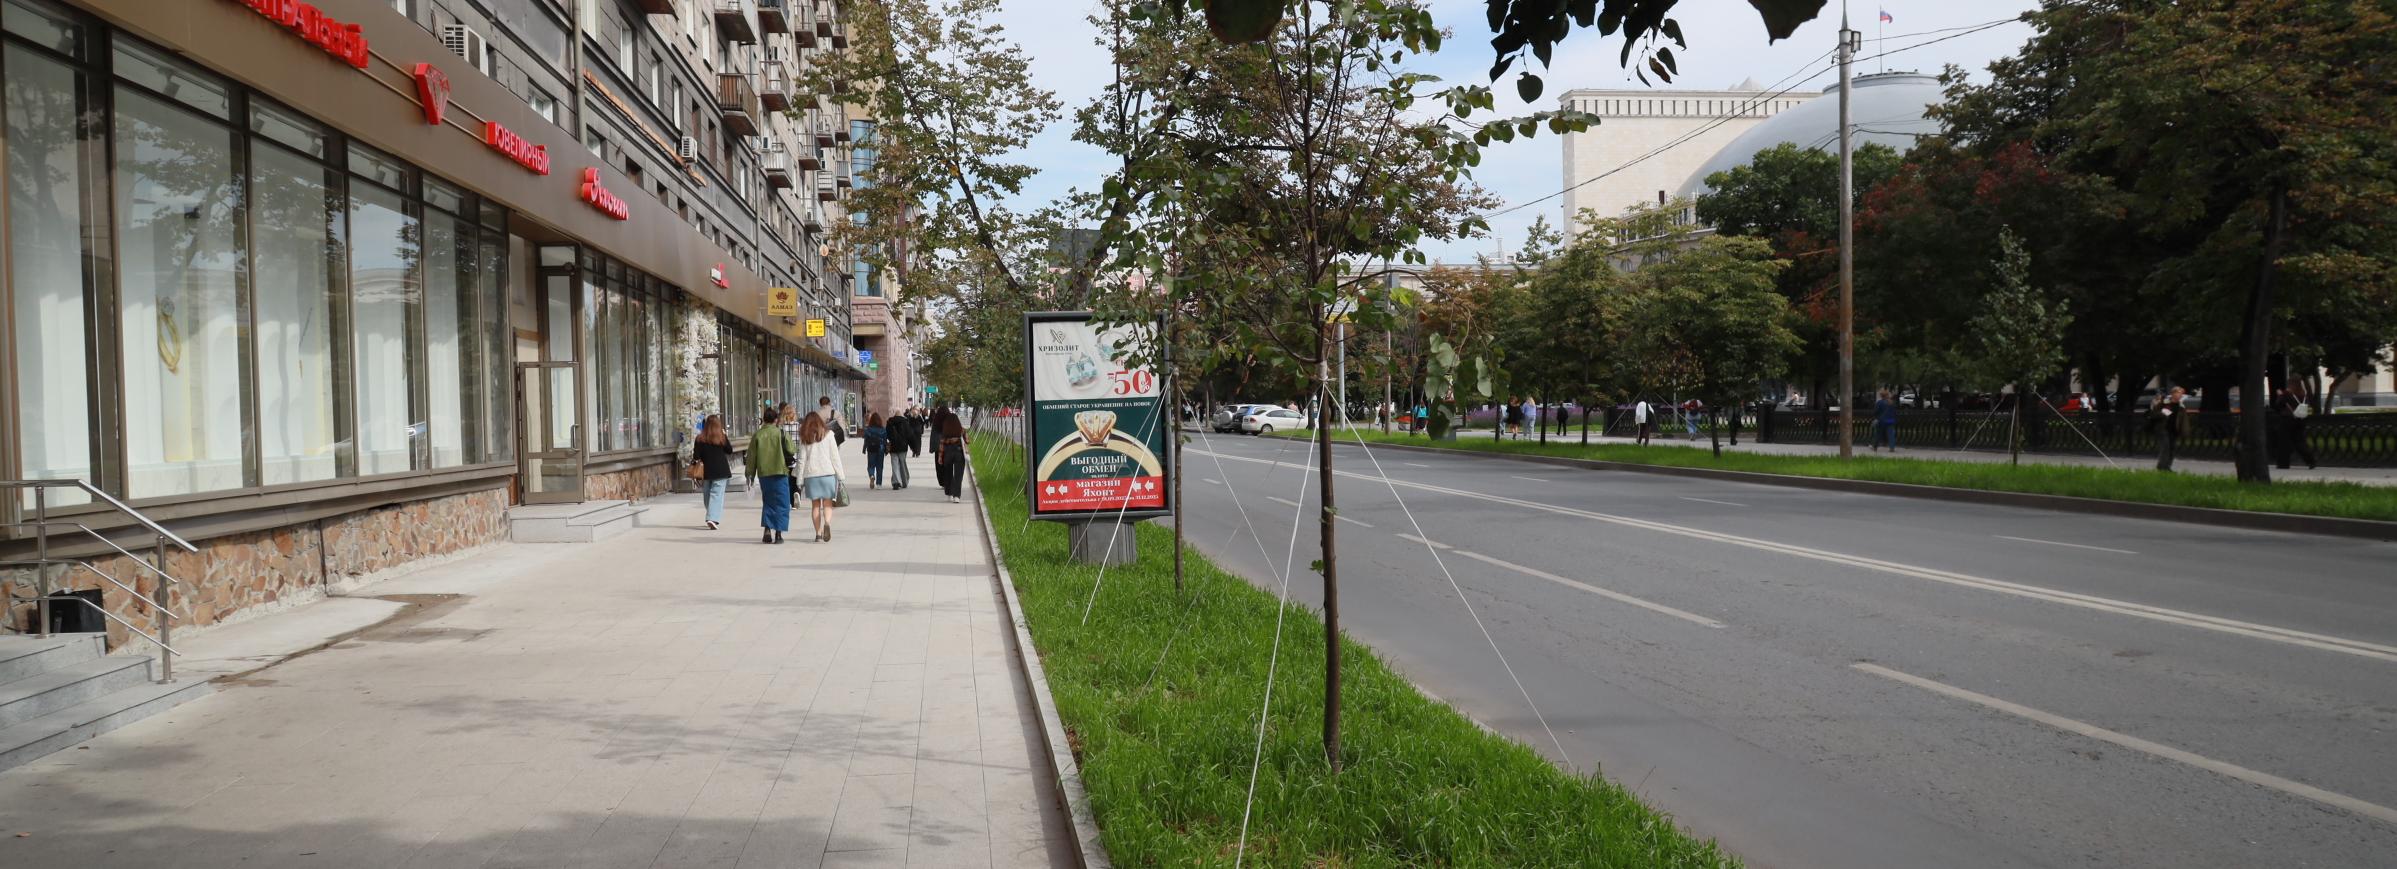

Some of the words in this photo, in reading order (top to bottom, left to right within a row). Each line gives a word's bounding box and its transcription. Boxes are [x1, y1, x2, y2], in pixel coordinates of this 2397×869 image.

[492, 122, 550, 175] ЮВЕЛИРНЫЙ
[1038, 344, 1079, 352] ХРИЗОЛИТ
[1071, 453, 1127, 466] ВЫГОДНЫЙ
[1082, 464, 1117, 474] ОБМЕН
[1076, 480, 1121, 488] магазин
[1083, 488, 1115, 497] Яхонт
